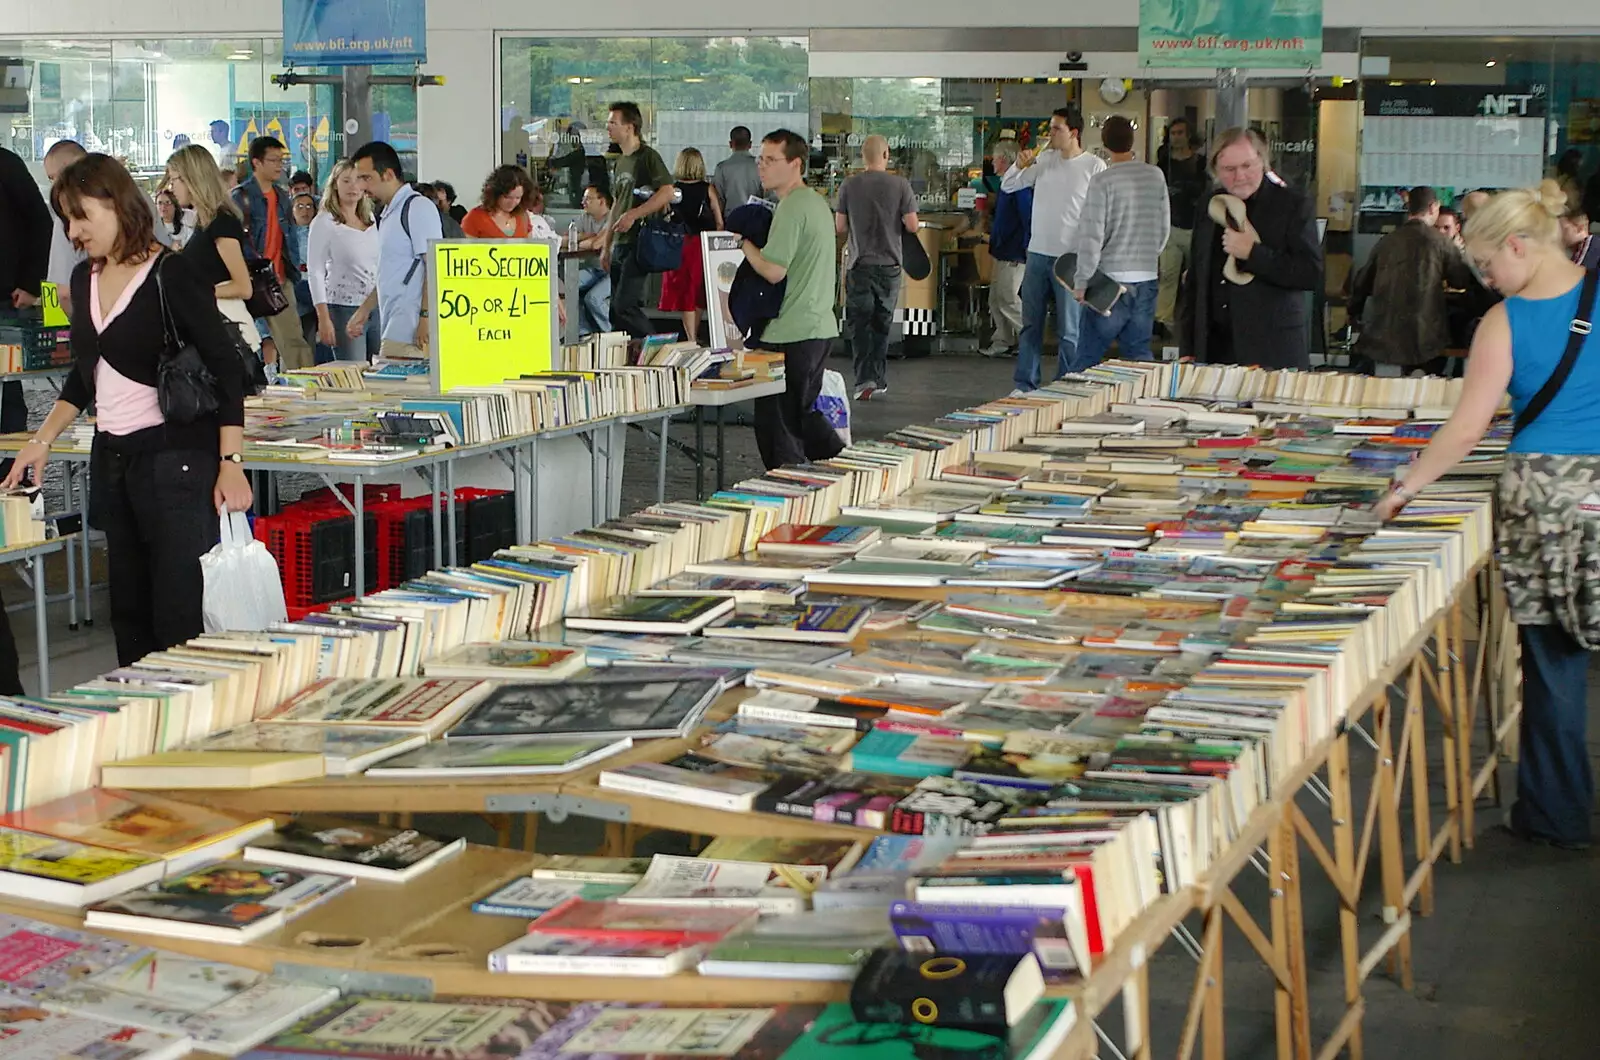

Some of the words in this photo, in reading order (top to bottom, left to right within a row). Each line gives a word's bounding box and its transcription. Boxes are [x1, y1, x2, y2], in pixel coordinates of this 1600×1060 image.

[292, 37, 413, 52] www.bfi.org.uk/nft
[1152, 36, 1304, 51] www.bfi.org.uk/nft
[759, 92, 798, 111] NFT
[1484, 94, 1532, 115] NFT
[1271, 139, 1315, 152] lmcafé
[439, 248, 482, 276] THIS
[487, 247, 548, 279] SECTION
[440, 290, 479, 325] 50p
[483, 298, 503, 313] OR
[478, 327, 511, 341] EACH
